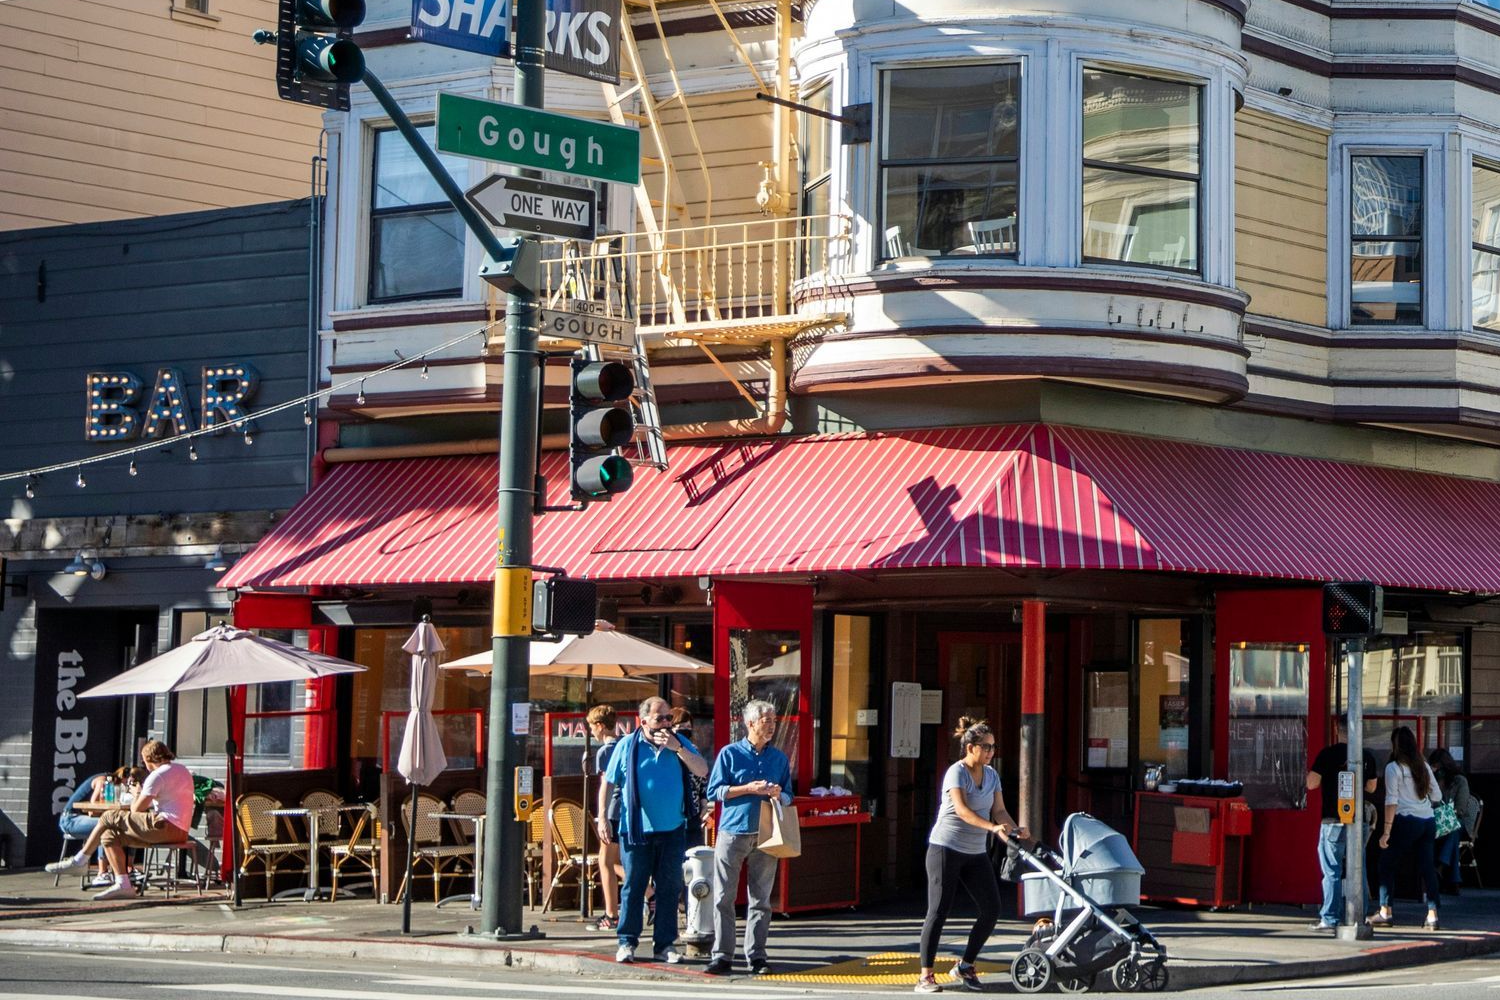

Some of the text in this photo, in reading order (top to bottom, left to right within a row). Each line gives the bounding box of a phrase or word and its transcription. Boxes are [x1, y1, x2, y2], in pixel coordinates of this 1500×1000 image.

[478, 115, 604, 170] Gough
[511, 193, 585, 222] ONE WAY
[576, 302, 595, 314] 400
[554, 317, 623, 341] GOUGH
[85, 363, 259, 442] BAR
[56, 649, 85, 712] the
[558, 721, 631, 737] MAN
